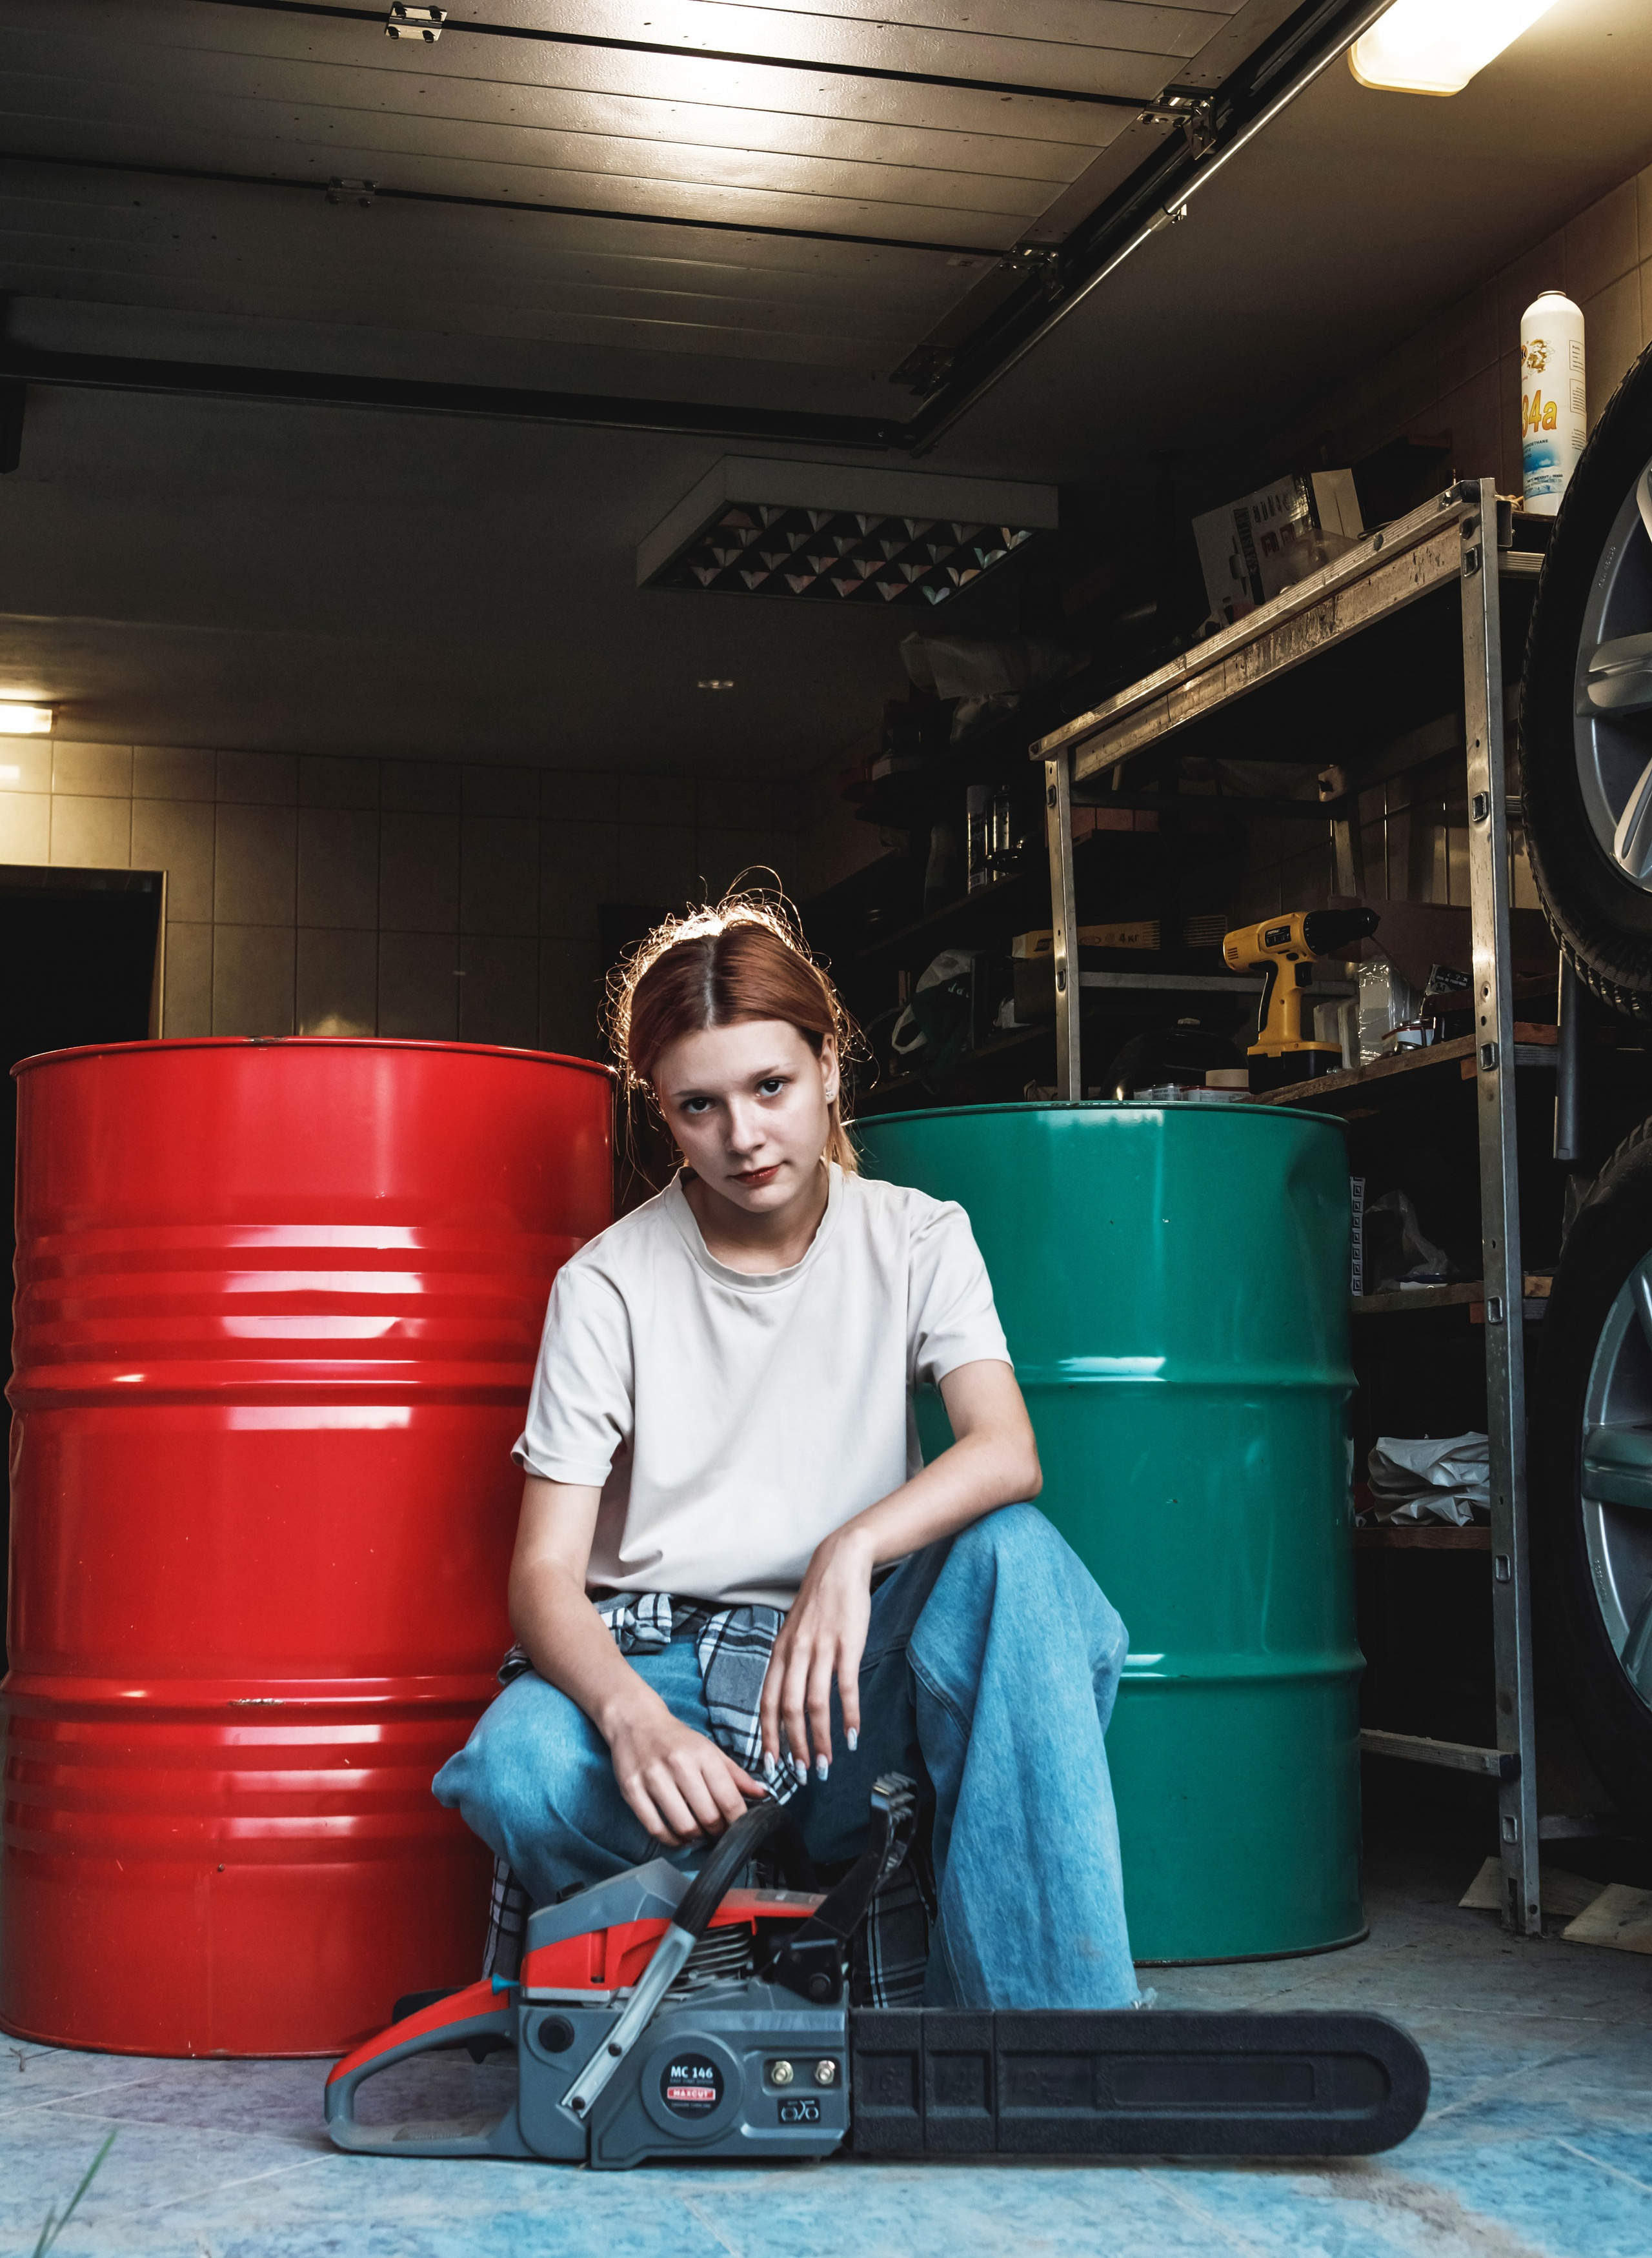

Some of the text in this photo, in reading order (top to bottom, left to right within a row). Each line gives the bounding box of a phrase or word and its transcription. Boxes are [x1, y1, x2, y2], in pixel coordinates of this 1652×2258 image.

[1120, 933, 1126, 943] 4
[671, 2066, 713, 2079] MC 146
